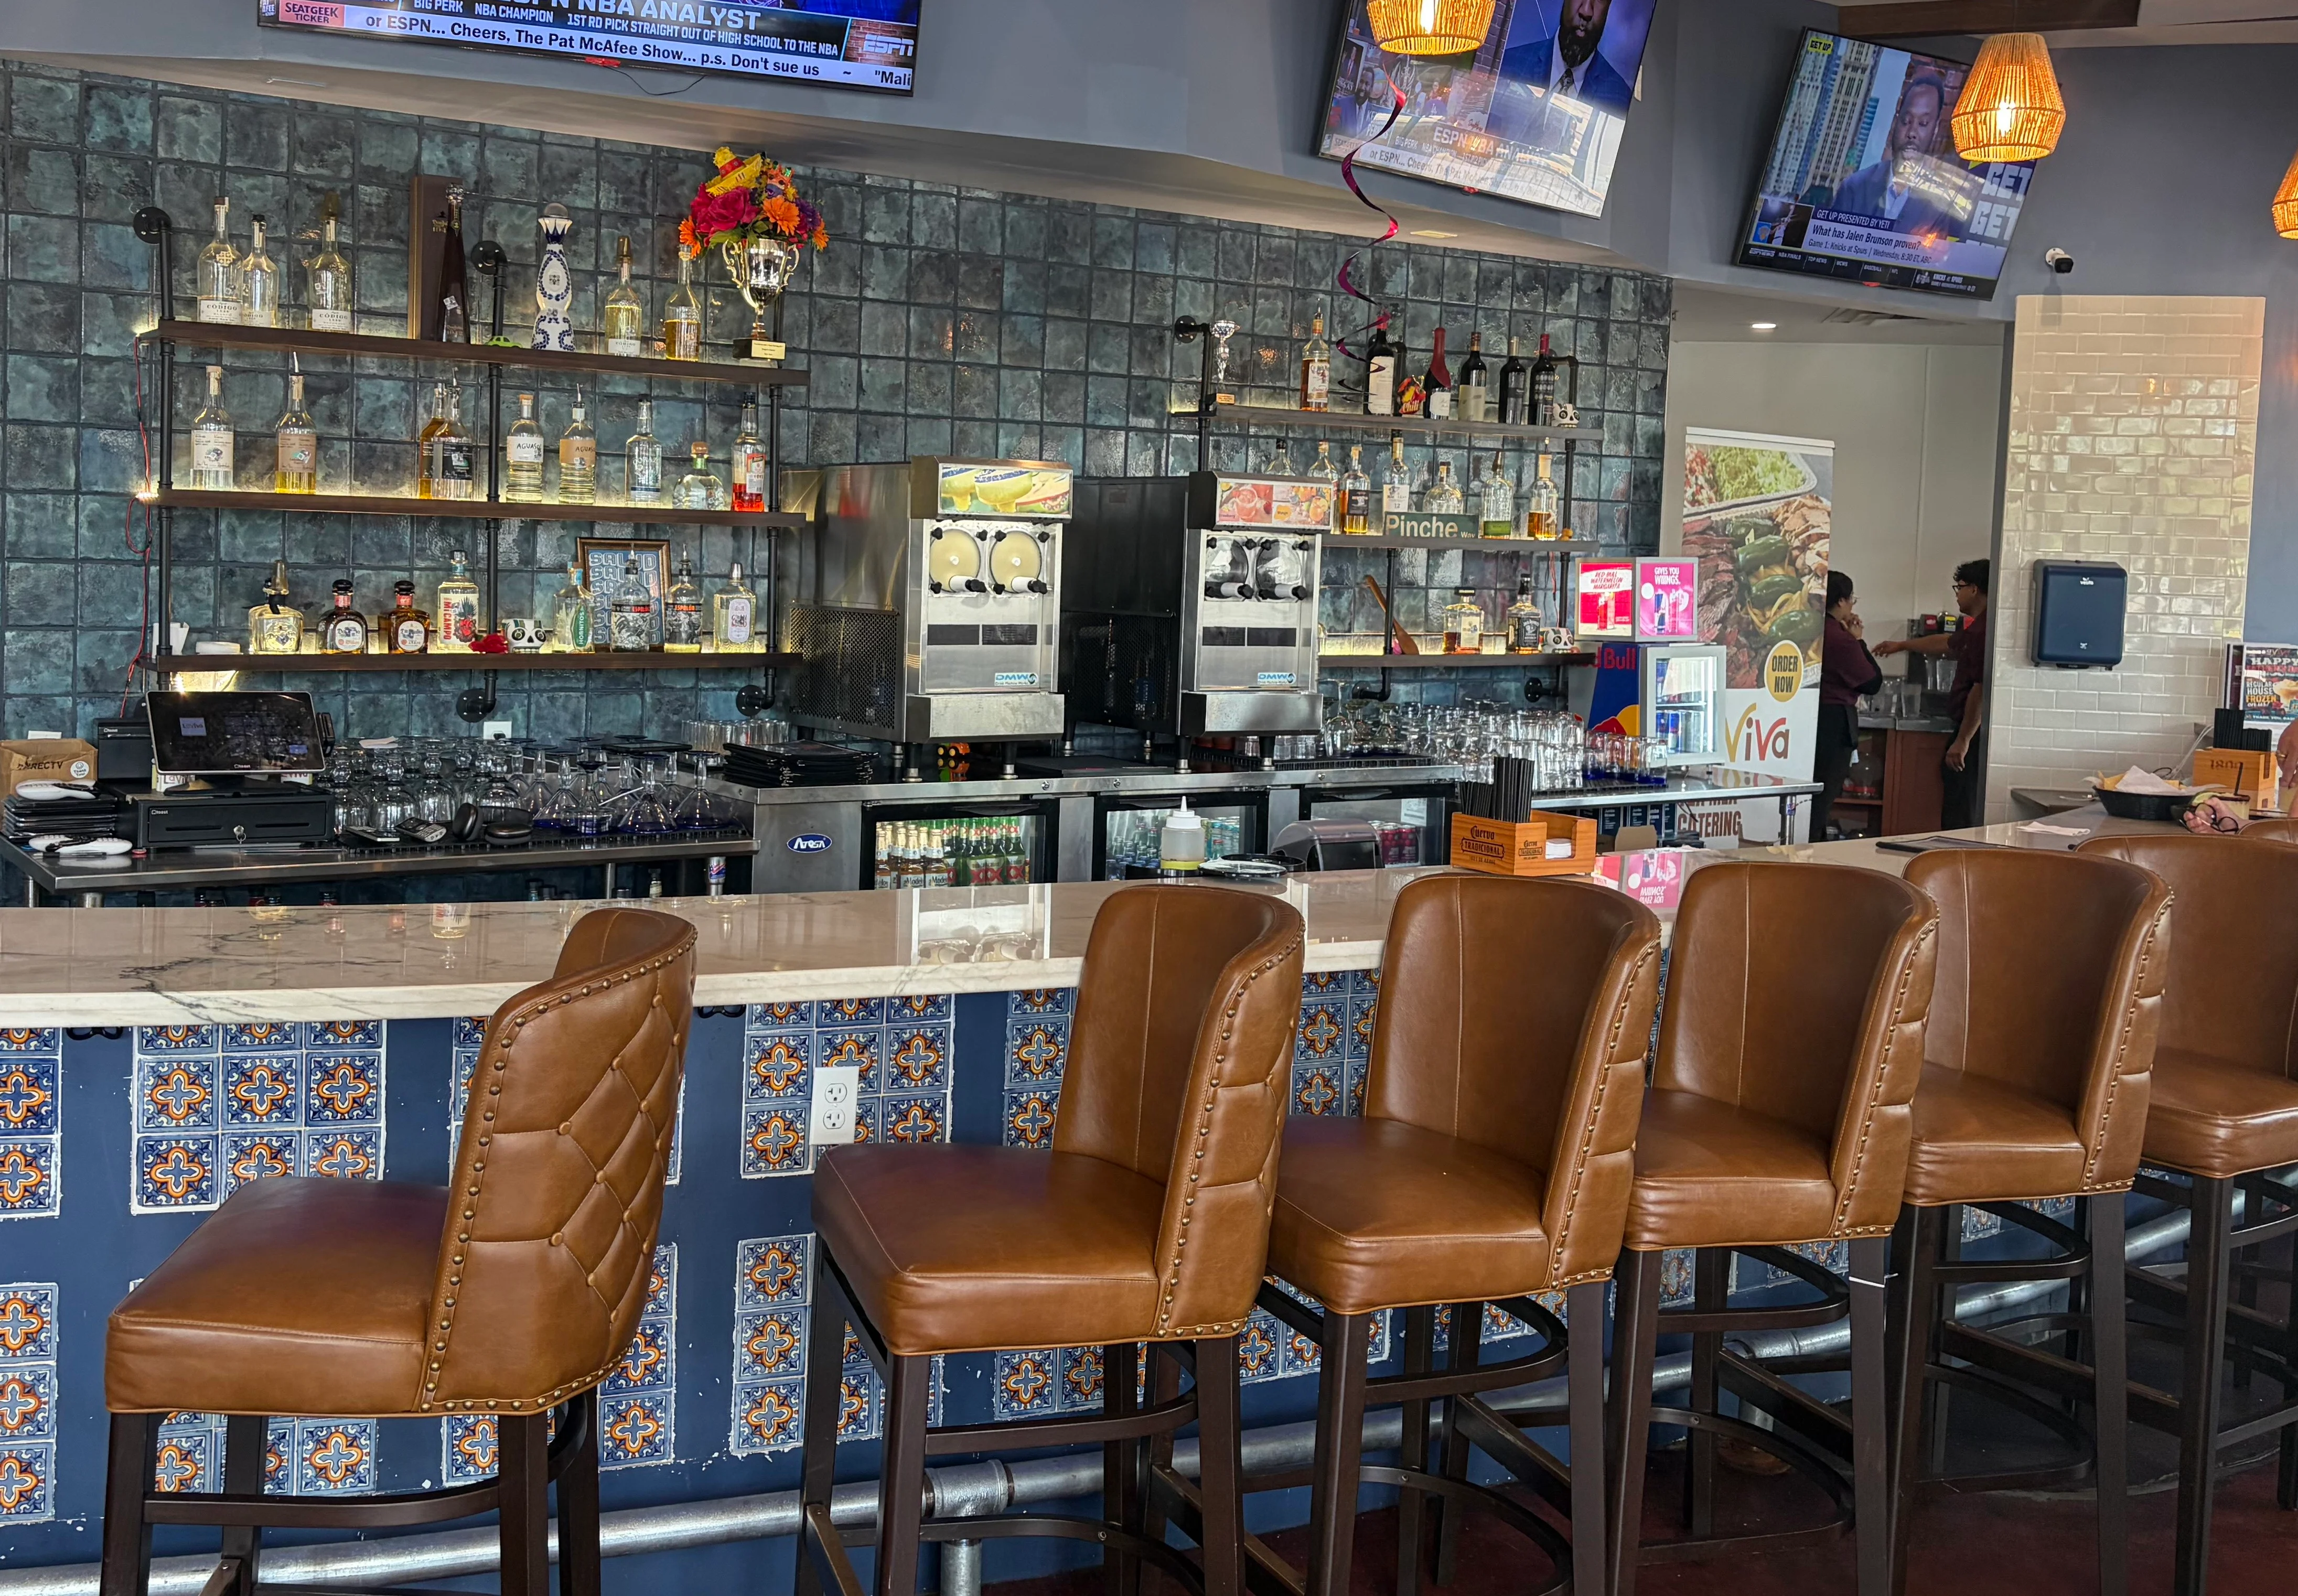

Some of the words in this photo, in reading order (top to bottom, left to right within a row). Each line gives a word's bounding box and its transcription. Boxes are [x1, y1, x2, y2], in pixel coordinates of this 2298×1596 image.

[285, 2, 338, 18] SEATGEEK
[295, 14, 329, 24] TICKER
[641, 0, 761, 30] ANALYST
[414, 0, 432, 9] BIG
[434, 0, 463, 13] PERK
[475, 4, 497, 17] NBA
[499, 6, 553, 23] CHAMPION
[567, 13, 586, 26] 1ST
[588, 15, 603, 29] RD
[605, 17, 628, 31] PICK
[630, 23, 680, 37] STRAIGHT
[682, 27, 701, 40] OUT
[703, 29, 716, 41] OF
[717, 30, 741, 45] HIGH
[744, 35, 782, 50] SCHOOL
[783, 38, 796, 51] TO
[798, 40, 816, 54] THE
[818, 42, 838, 56] NBA
[366, 15, 382, 27] or
[387, 15, 446, 35] ESPN...
[450, 23, 510, 44] Cheers,
[515, 29, 543, 45] The
[549, 34, 574, 48] Pat
[579, 37, 637, 55] McAfee
[642, 44, 696, 62] Show...
[701, 55, 726, 66] p.s.
[732, 54, 768, 70] Don't
[773, 61, 798, 73] sue
[803, 64, 819, 76] us
[864, 34, 914, 56] ESPN
[1810, 40, 1823, 49] GET
[1822, 42, 1831, 51] UP
[1433, 126, 1468, 148] ESPN
[1370, 150, 1379, 159] or
[1982, 162, 2033, 201] GET
[1817, 209, 1829, 219] GET
[1829, 211, 1837, 220] UP
[1838, 212, 1870, 225] PRESENTED
[1870, 219, 1878, 227] BY
[1878, 220, 1891, 229] YETI
[1969, 200, 2021, 241] GET
[1812, 224, 1830, 238] What
[1832, 228, 1845, 239] has
[1845, 231, 1864, 242] Jalen
[1865, 233, 1893, 246] Brunson
[1894, 239, 1921, 251] proven?
[1809, 239, 1823, 248] Game
[1830, 242, 1846, 251] Knicks
[1854, 246, 1867, 255] Spurs
[1873, 249, 1900, 261] Wednesday,
[1385, 515, 1458, 538] Pinche
[1604, 647, 1636, 670] Bull
[1772, 655, 1798, 672] ORDER
[2250, 657, 2298, 666] HAPPY
[1774, 676, 1794, 693] NOW
[1678, 811, 1742, 838] CATERING
[1465, 841, 1501, 855] TRADICIONAL
